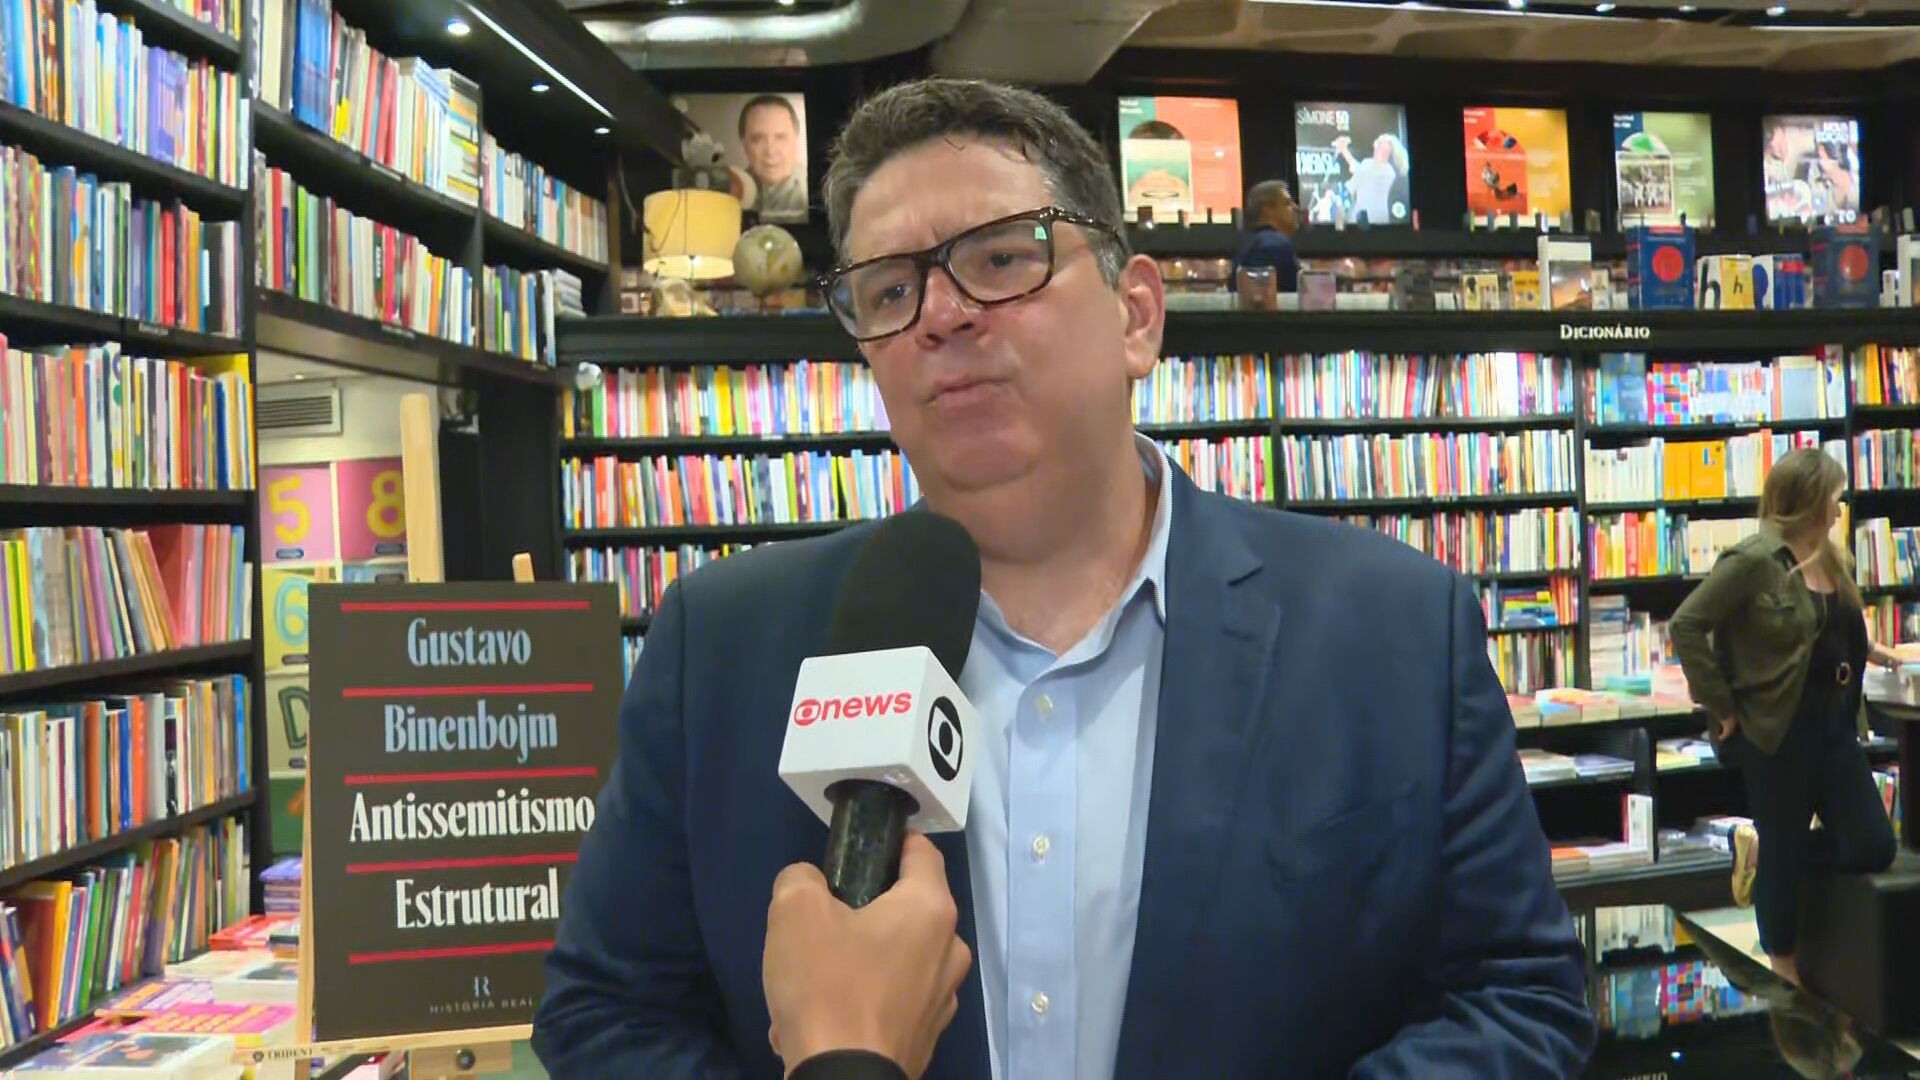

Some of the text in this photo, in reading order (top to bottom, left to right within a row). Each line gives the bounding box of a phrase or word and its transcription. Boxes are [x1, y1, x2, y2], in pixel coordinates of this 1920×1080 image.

[268, 475, 311, 544] 5
[407, 617, 532, 667] Gustavo
[384, 699, 558, 764] Binenbojm
[349, 787, 596, 842] Antissemitismo
[396, 867, 560, 928] Estrutural
